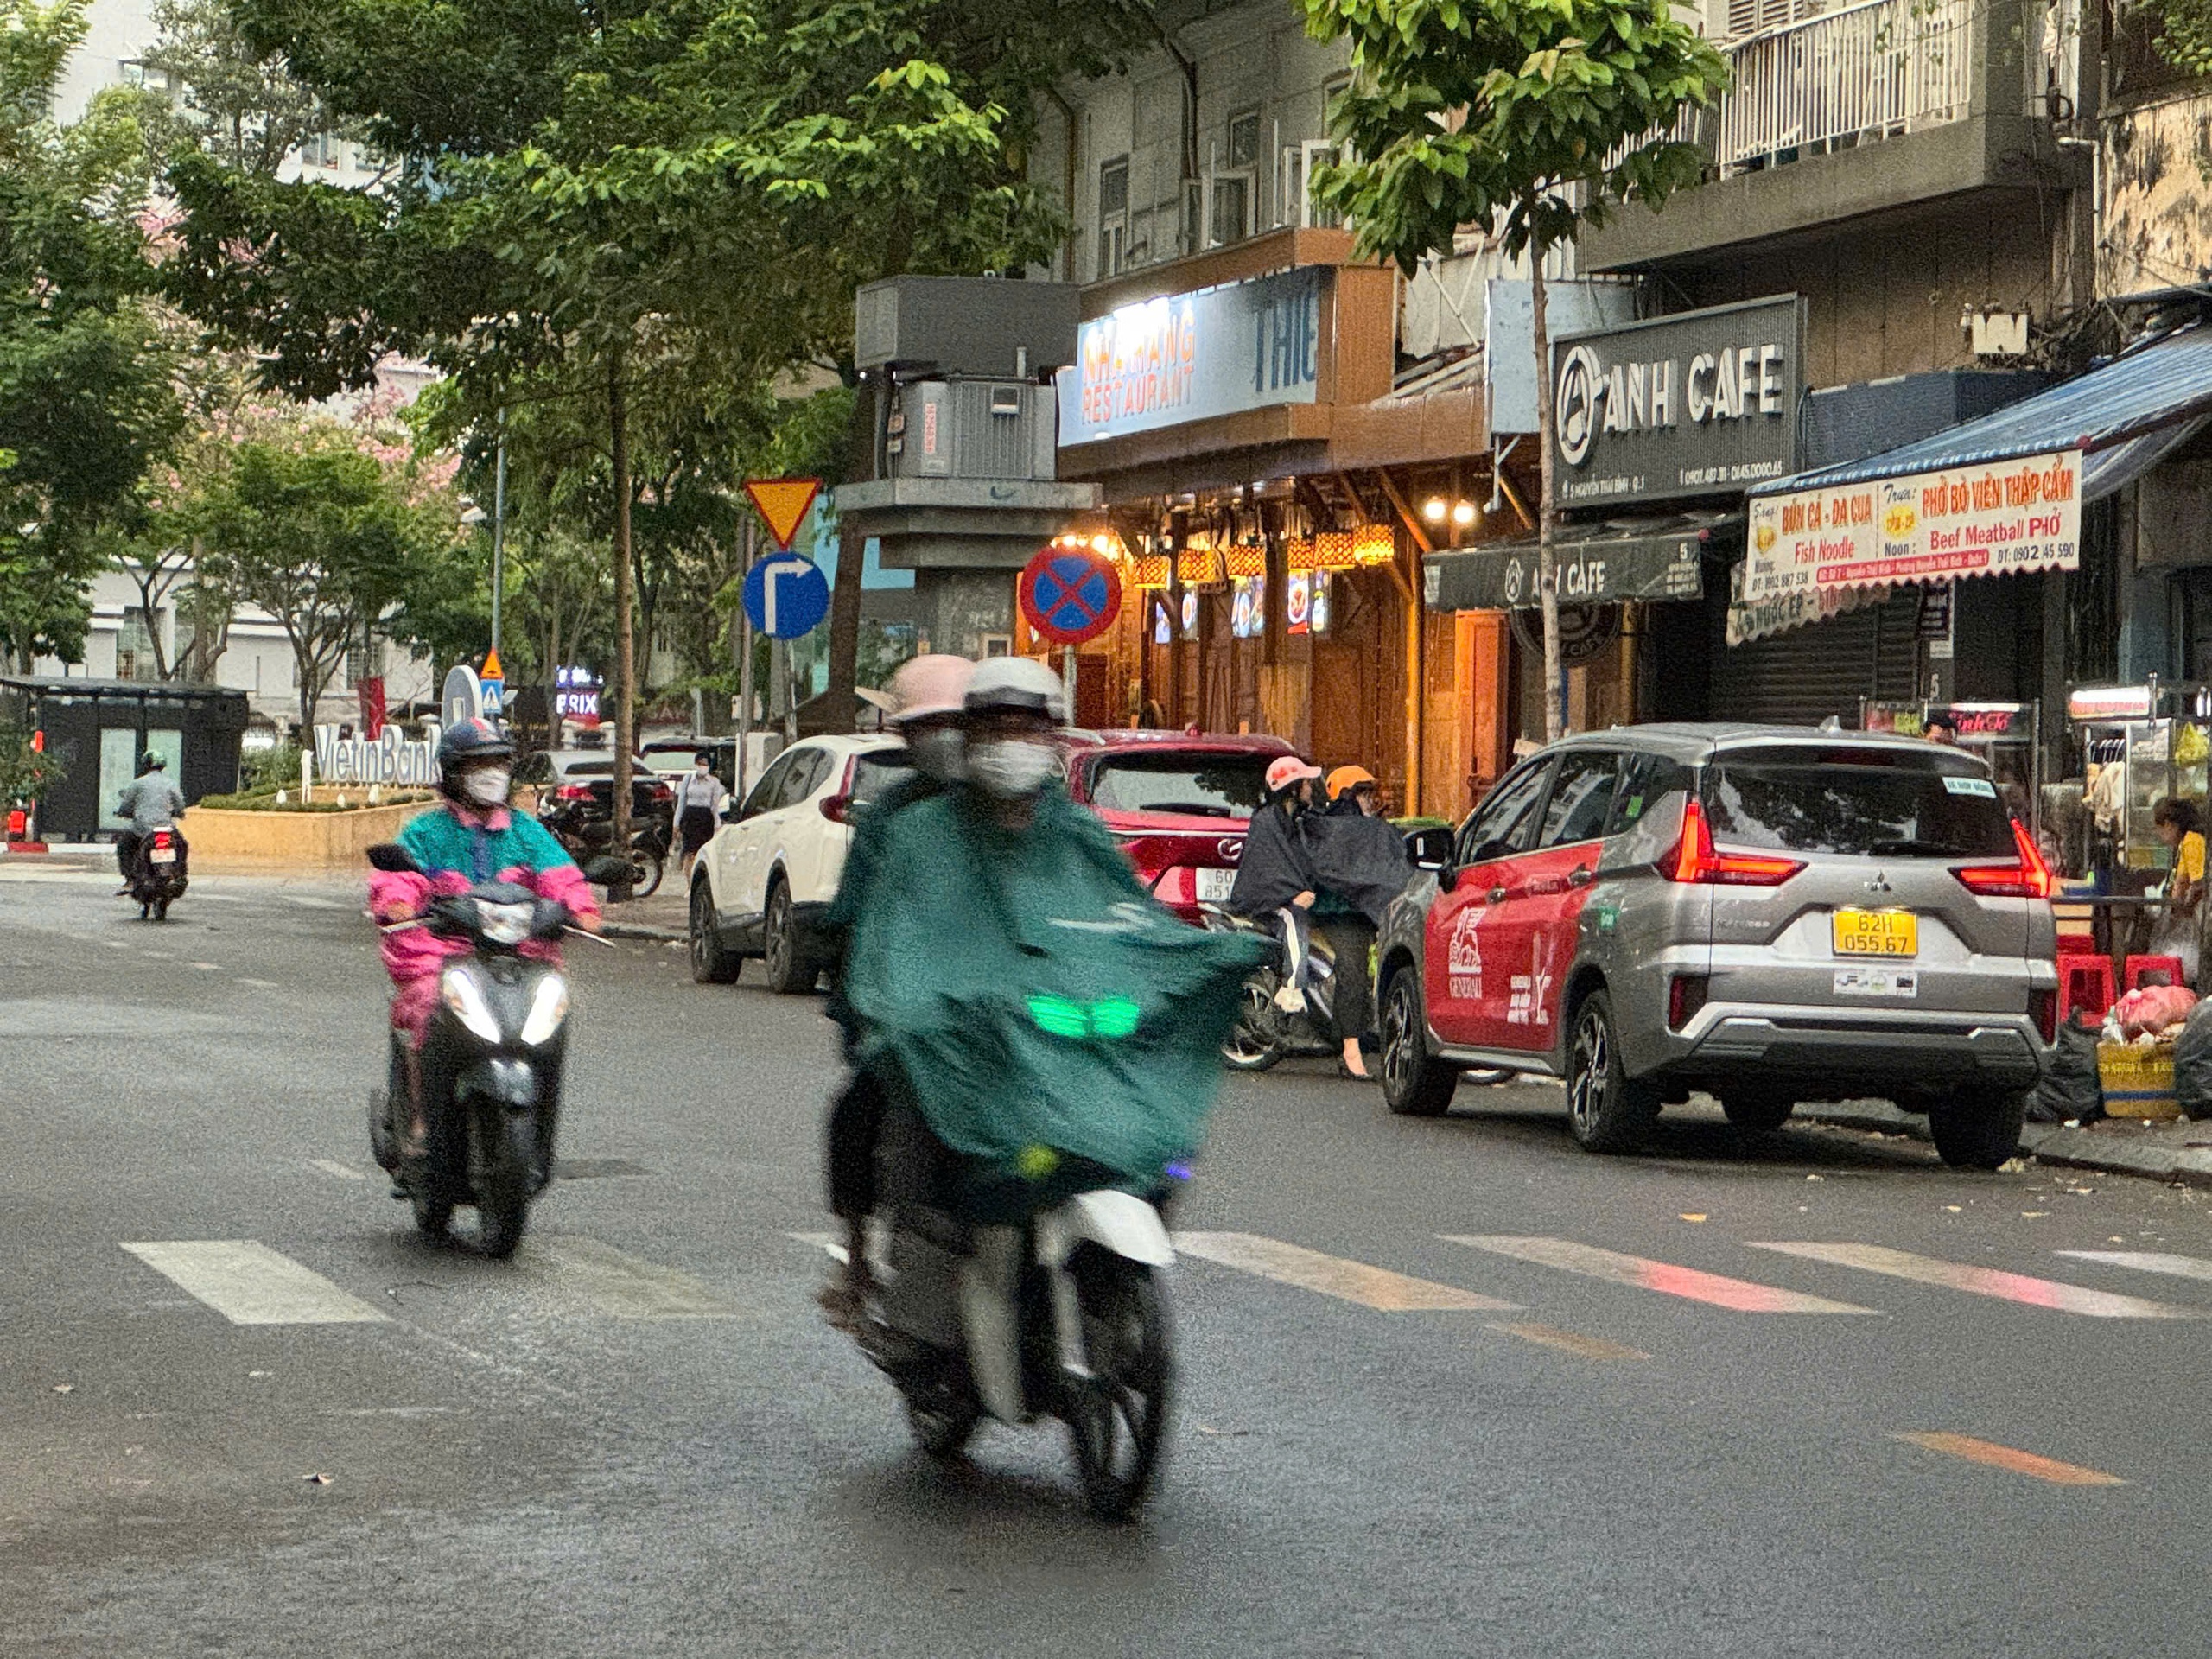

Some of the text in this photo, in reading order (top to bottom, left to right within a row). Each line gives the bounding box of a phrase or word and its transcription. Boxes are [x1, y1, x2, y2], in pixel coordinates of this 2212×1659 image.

[1082, 365, 1194, 425] RESTAURANT
[1604, 344, 1782, 432] ANH CAFE
[1851, 493, 1872, 525] CUA
[1795, 535, 1855, 565] Fish Noodle
[1930, 526, 1959, 550] Beef
[1965, 518, 2024, 545] Meatball
[1567, 561, 1606, 596] CAFE
[313, 723, 443, 785] VietinBank
[1216, 870, 1233, 883] 60
[1859, 914, 1893, 933] 62H
[1845, 934, 1909, 953] 055.67
